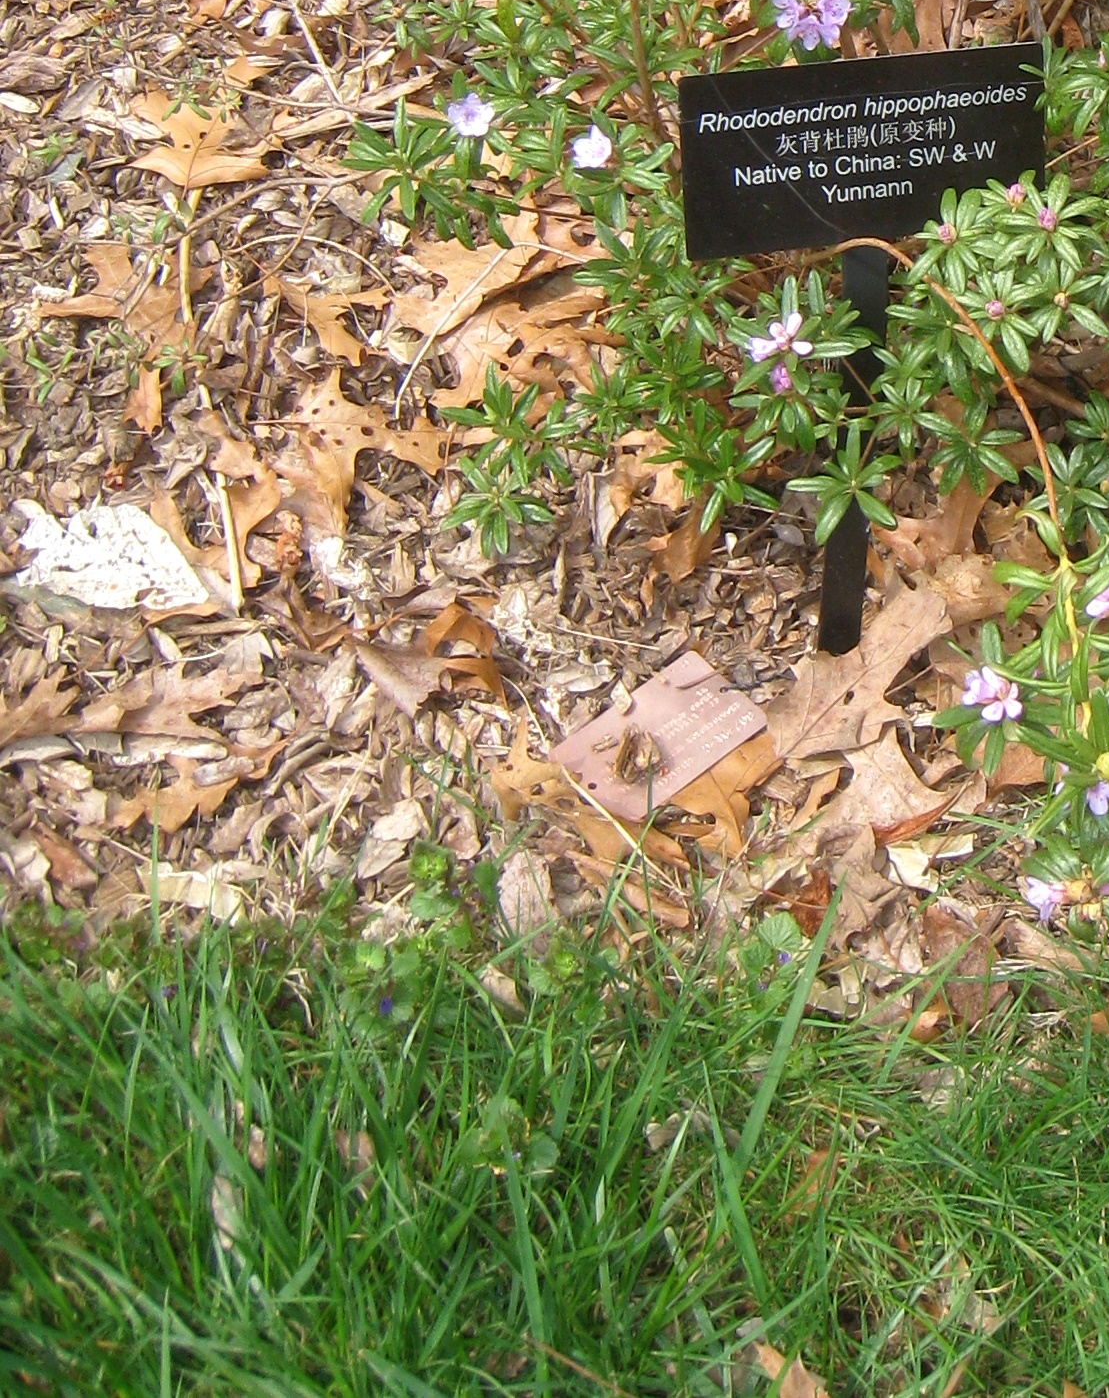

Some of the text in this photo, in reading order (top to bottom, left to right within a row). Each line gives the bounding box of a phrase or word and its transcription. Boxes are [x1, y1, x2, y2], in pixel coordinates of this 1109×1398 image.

[699, 85, 1027, 134] Rhododendron hippophaeoides
[775, 115, 957, 157] 灰背杜鹃(原变种)
[734, 140, 996, 187] Native to China: SW & W
[821, 180, 913, 204] Yunnann
